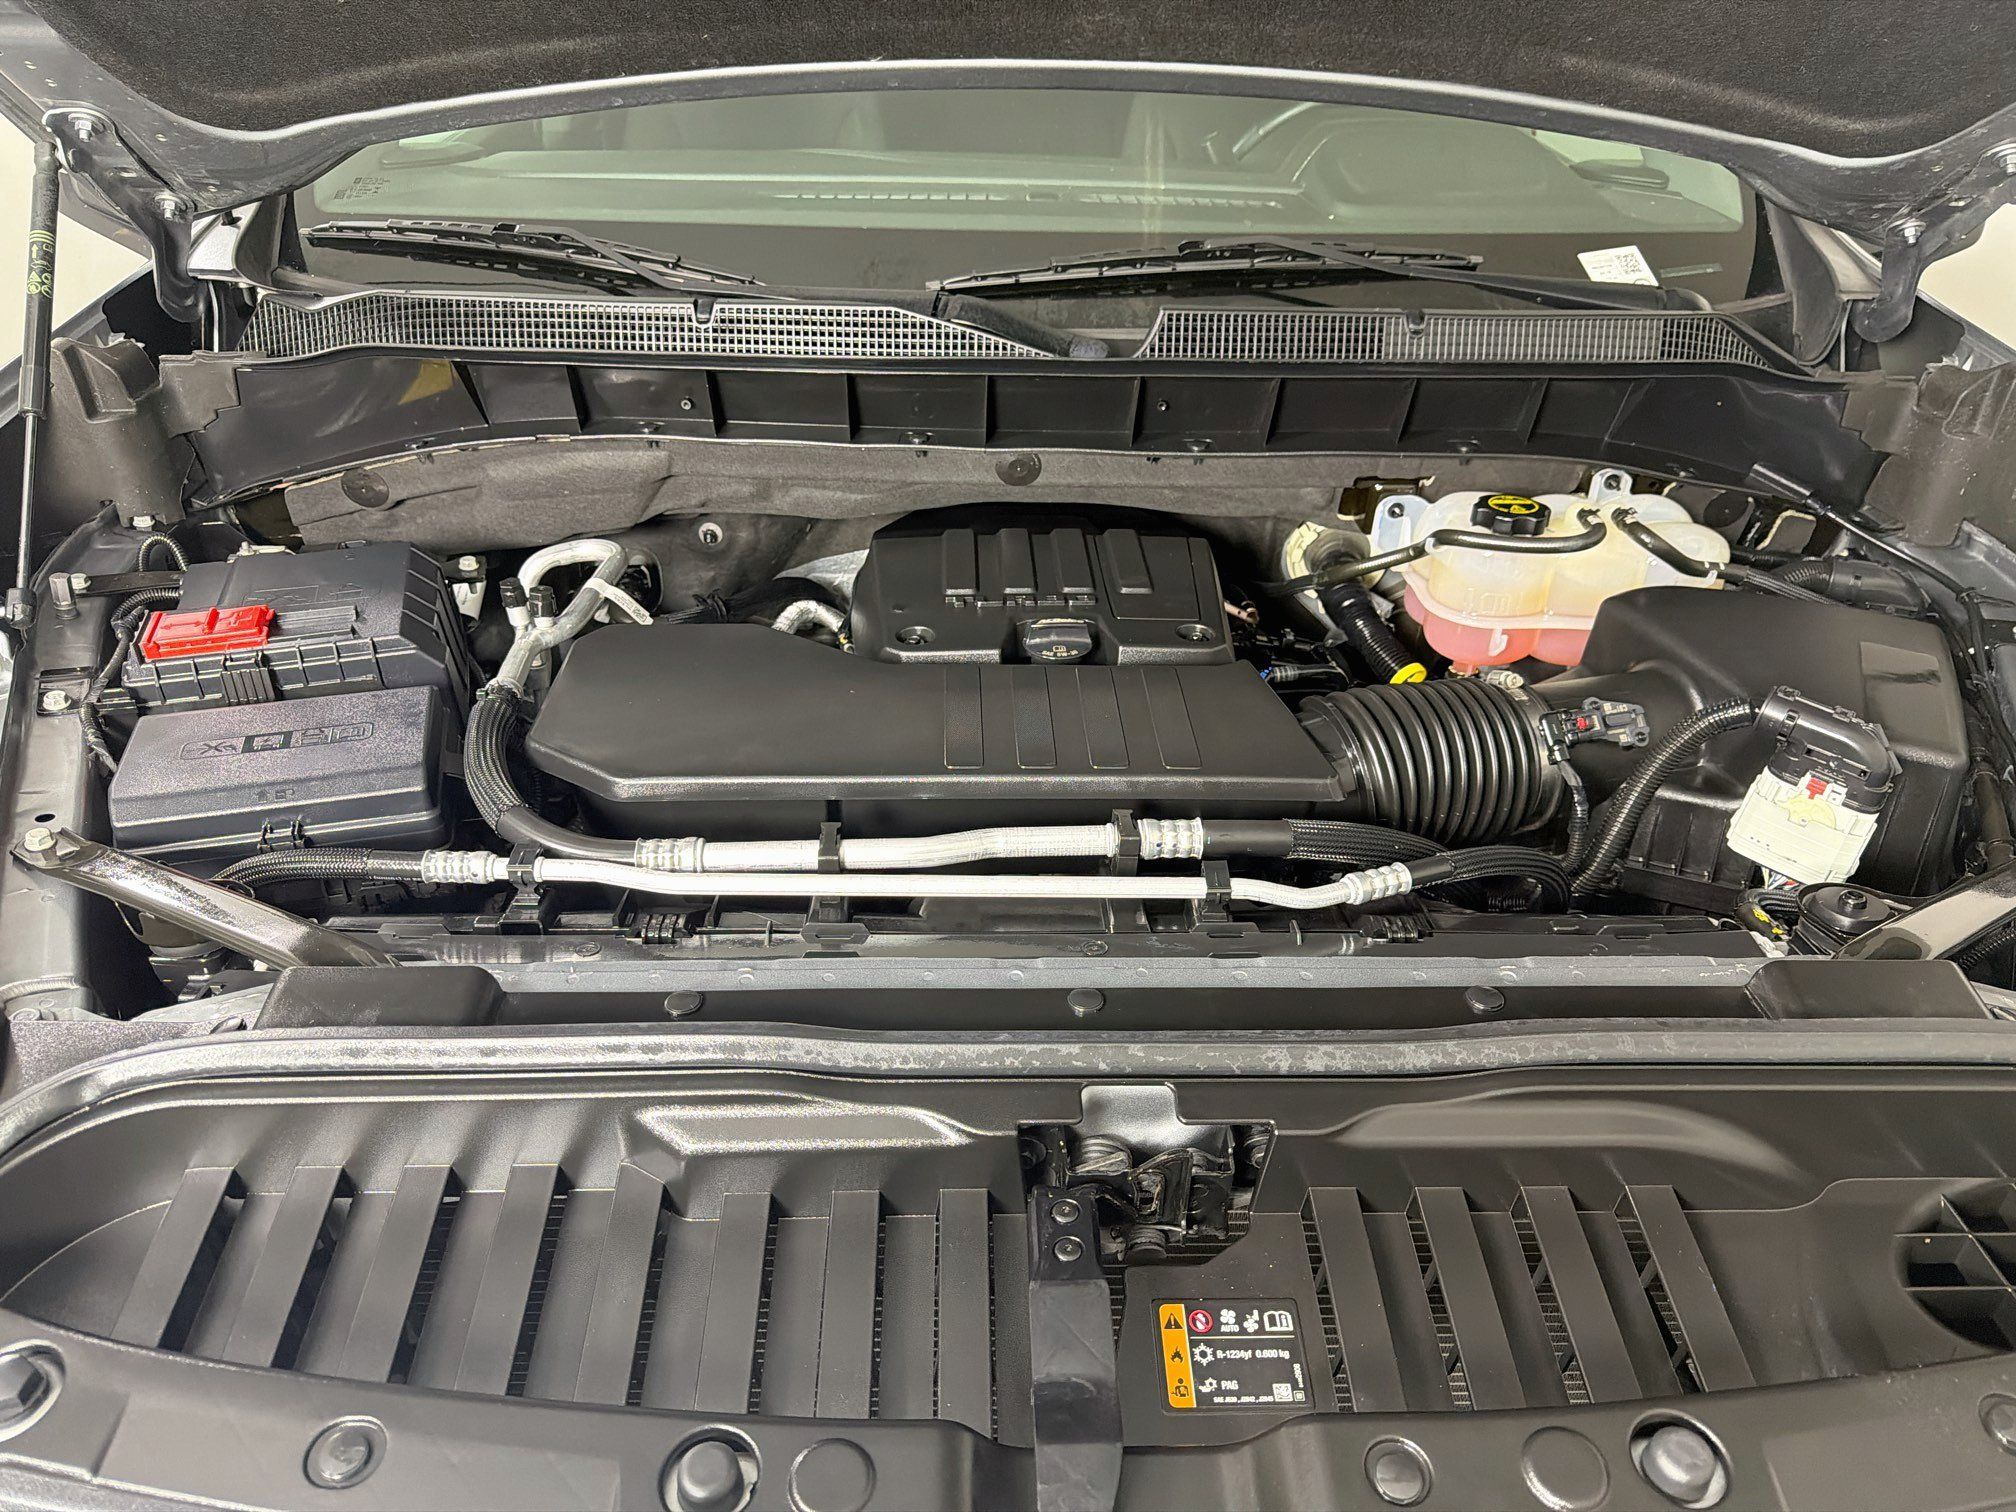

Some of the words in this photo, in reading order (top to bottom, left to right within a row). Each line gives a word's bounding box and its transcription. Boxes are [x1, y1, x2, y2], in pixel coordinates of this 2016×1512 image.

[1216, 1350, 1252, 1360] R-1234yf
[1255, 1349, 1278, 1359] 0.600
[1279, 1349, 1290, 1359] kg
[1221, 1380, 1239, 1390] PAG
